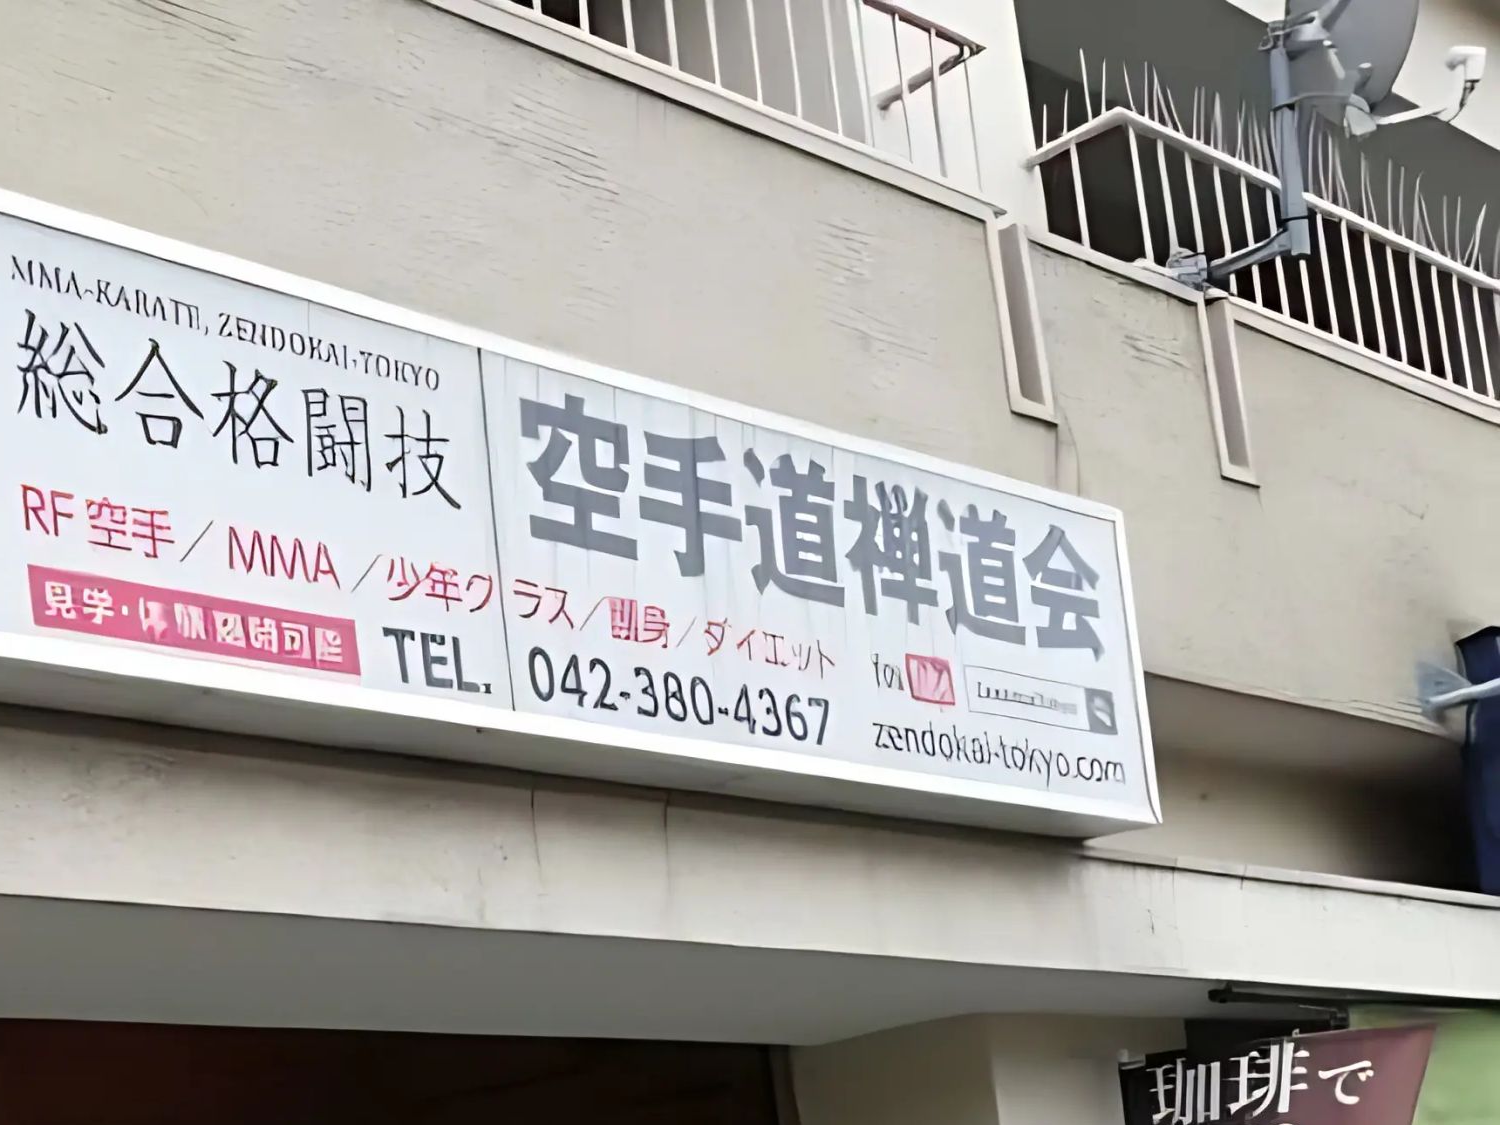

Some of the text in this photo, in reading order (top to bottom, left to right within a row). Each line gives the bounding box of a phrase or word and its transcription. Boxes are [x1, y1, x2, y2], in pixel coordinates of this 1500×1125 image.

[15, 308, 462, 510] 総合格闘技
[519, 392, 1103, 662] 空手道禅道会
[382, 626, 492, 694] TEL.
[527, 645, 830, 746] 042-380-4367
